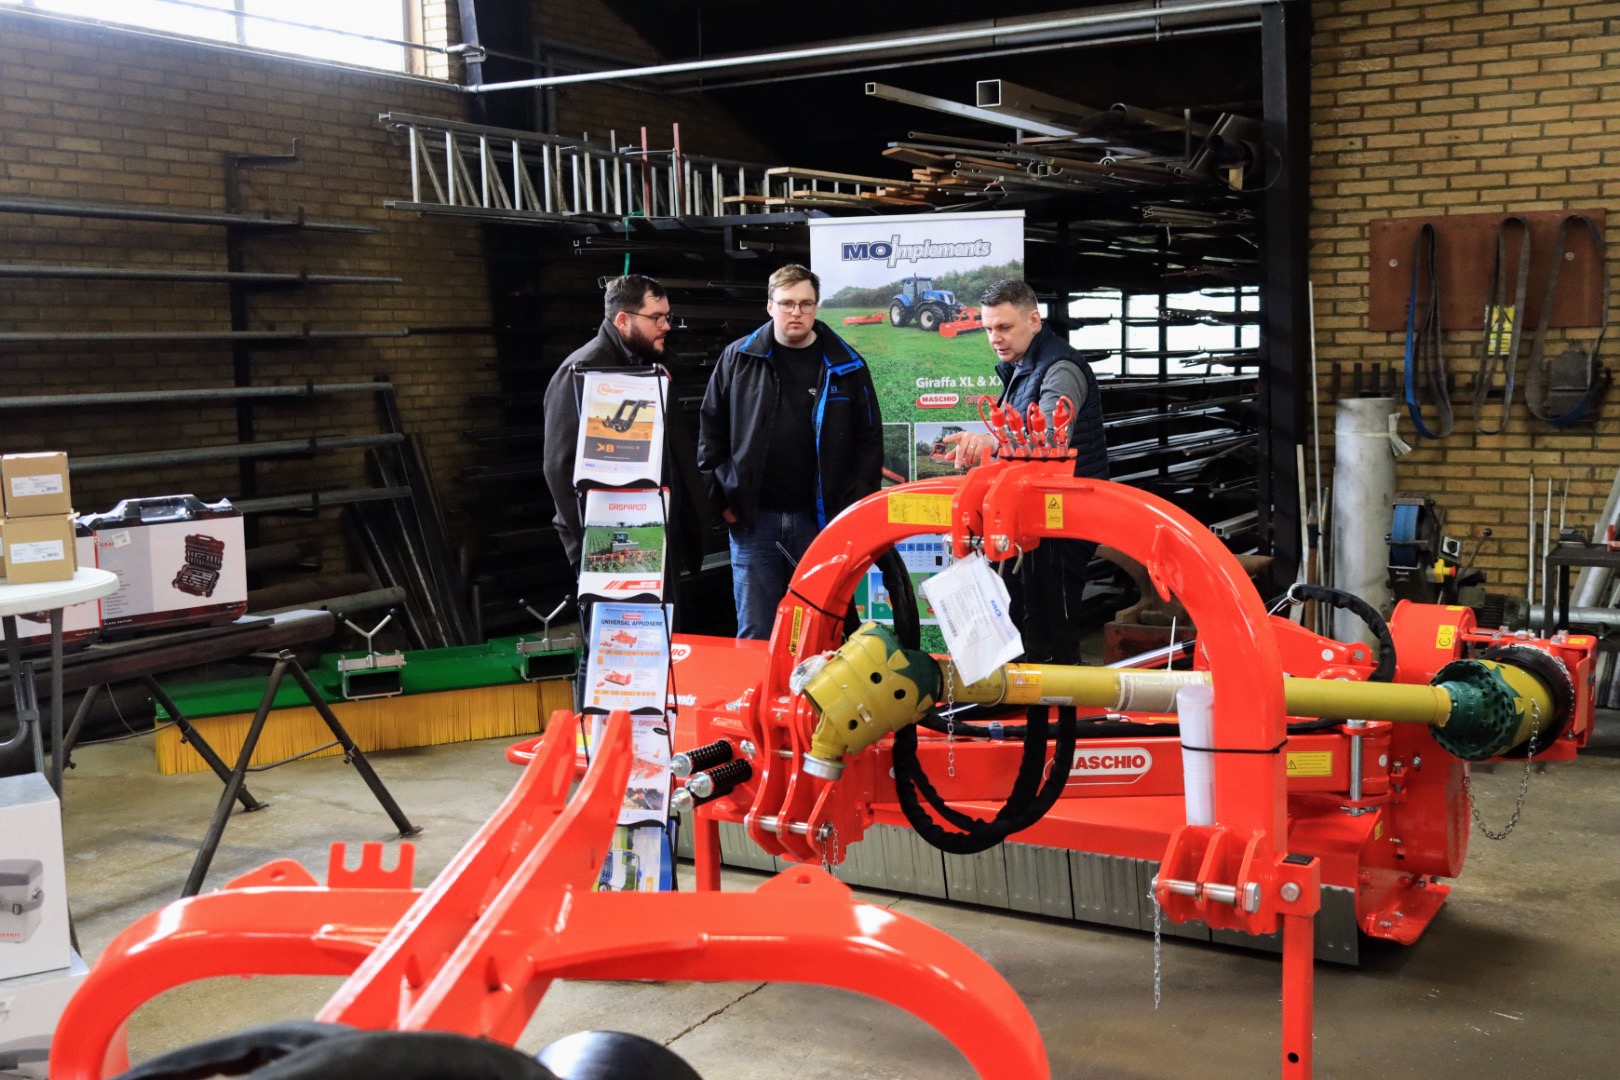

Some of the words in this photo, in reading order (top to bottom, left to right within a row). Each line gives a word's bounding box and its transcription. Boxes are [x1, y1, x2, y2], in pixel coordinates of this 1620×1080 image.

[916, 377, 957, 388] Giraffa
[959, 376, 974, 387] XL
[977, 376, 986, 387] &
[608, 503, 647, 511] GASPARDO
[1071, 755, 1146, 770] ASCHIO
